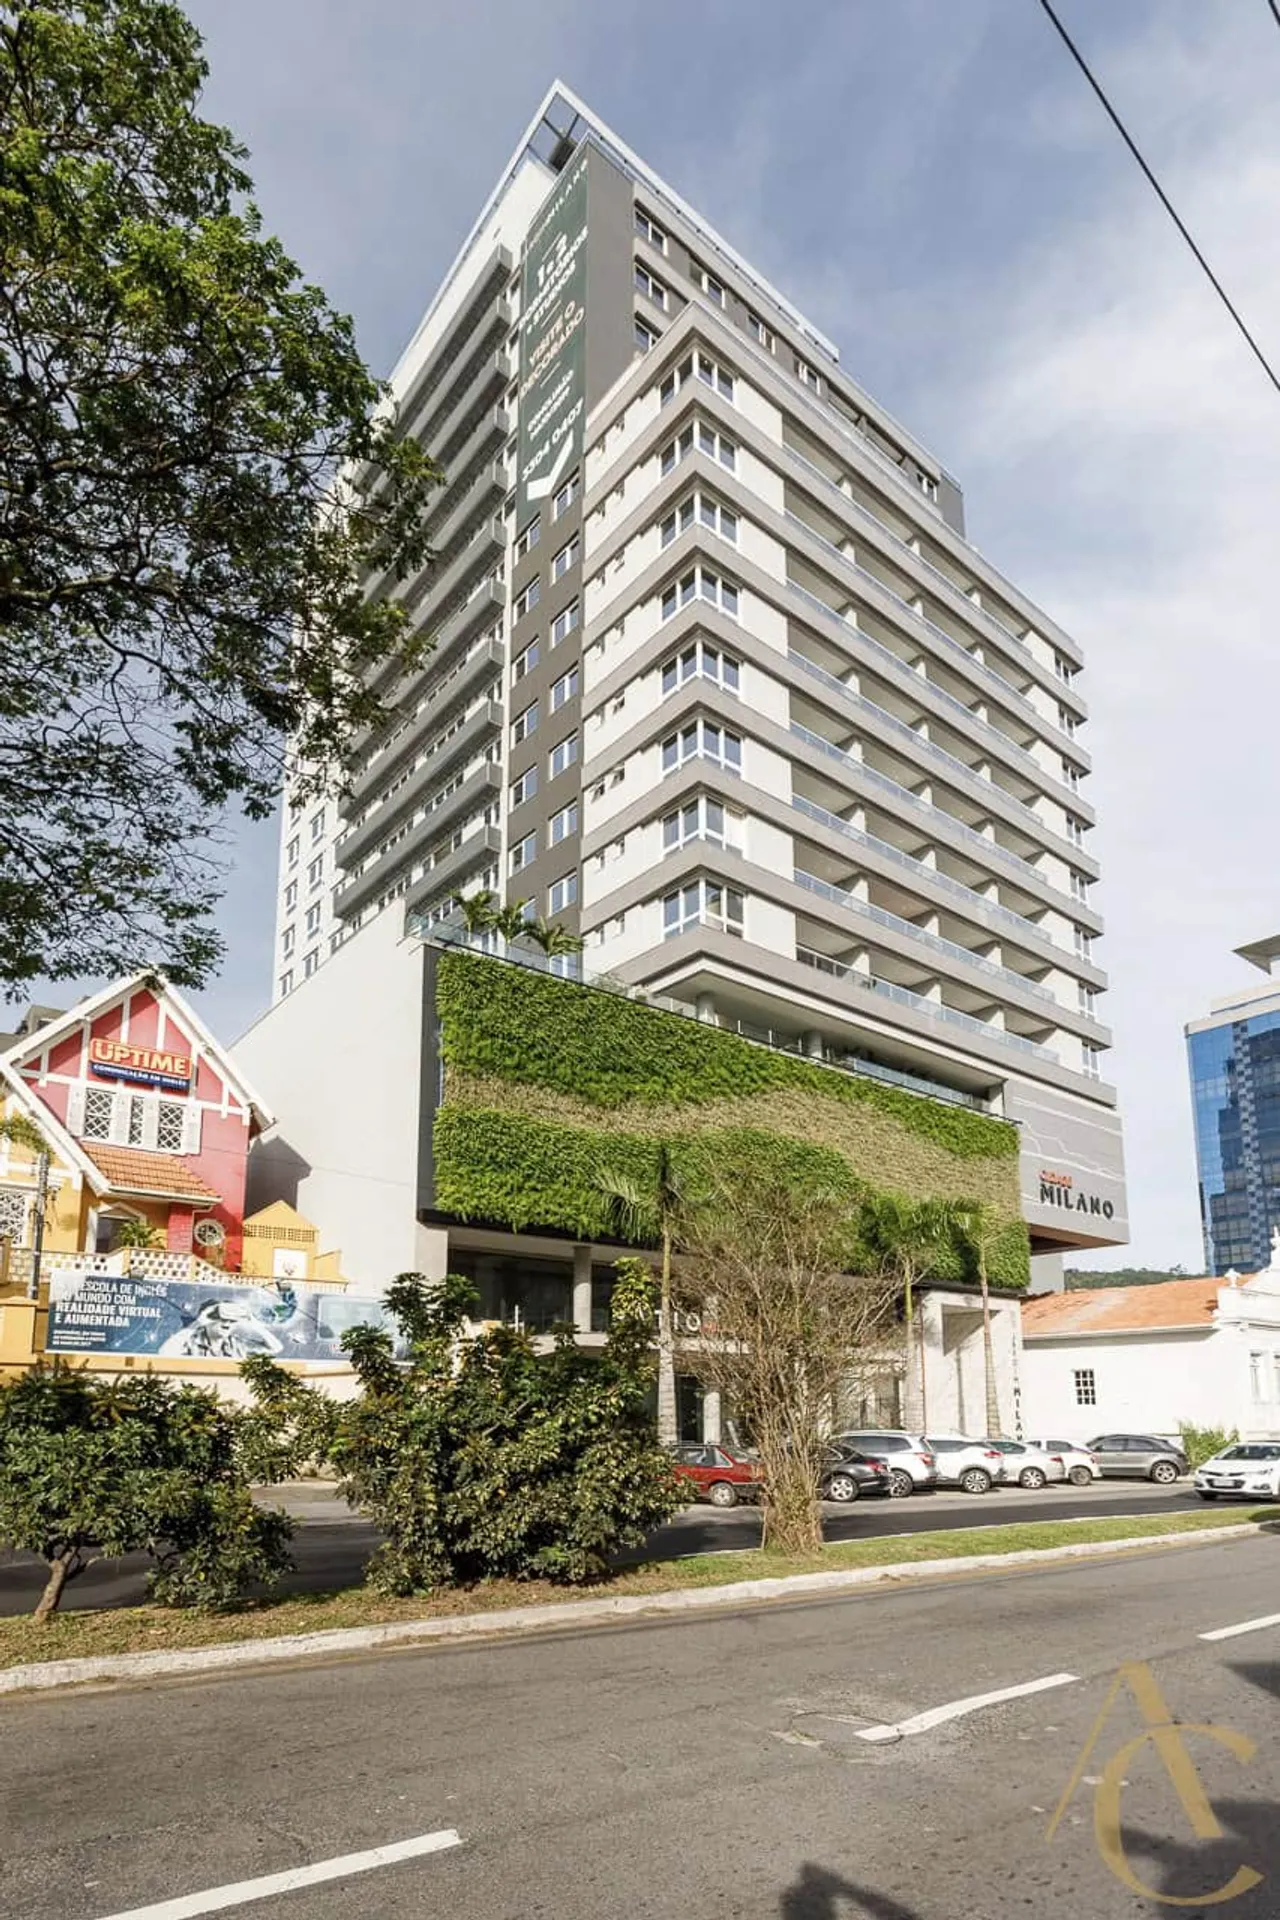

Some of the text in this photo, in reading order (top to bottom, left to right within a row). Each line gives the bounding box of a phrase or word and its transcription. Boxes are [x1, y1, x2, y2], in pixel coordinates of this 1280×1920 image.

[564, 300, 575, 319] O
[519, 306, 585, 400] DECORADO
[95, 1042, 187, 1075] UPTIME
[1040, 1183, 1114, 1219] MILANO
[82, 1281, 118, 1293] ESCOLA
[120, 1284, 134, 1294] DE
[114, 1294, 136, 1306] COM
[56, 1301, 162, 1319] REALIDADE VIRTUAL
[54, 1312, 131, 1328] E AUMENTADA
